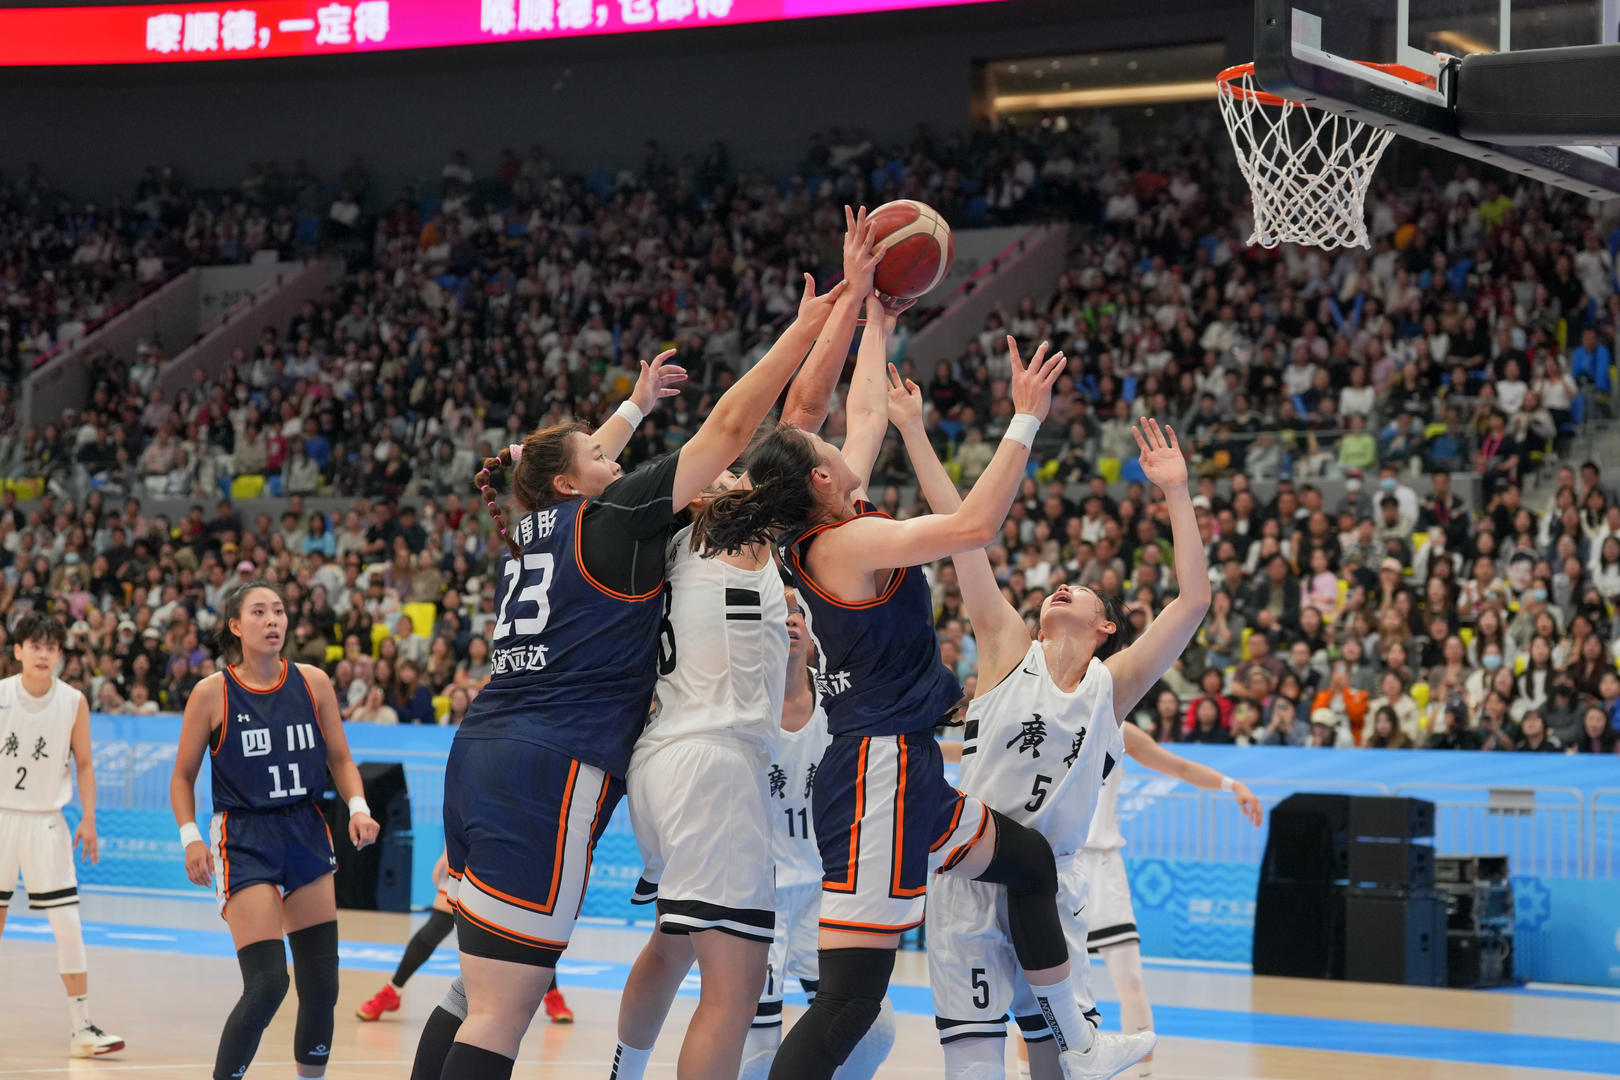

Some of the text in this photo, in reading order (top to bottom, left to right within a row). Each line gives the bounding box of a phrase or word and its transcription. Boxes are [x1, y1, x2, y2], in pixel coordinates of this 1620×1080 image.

[493, 552, 554, 640] 23
[241, 723, 316, 757] 四川
[15, 766, 27, 790] 2
[268, 762, 307, 799] 11
[1024, 774, 1052, 812] 5
[784, 807, 809, 839] 11
[971, 968, 989, 1009] 5
